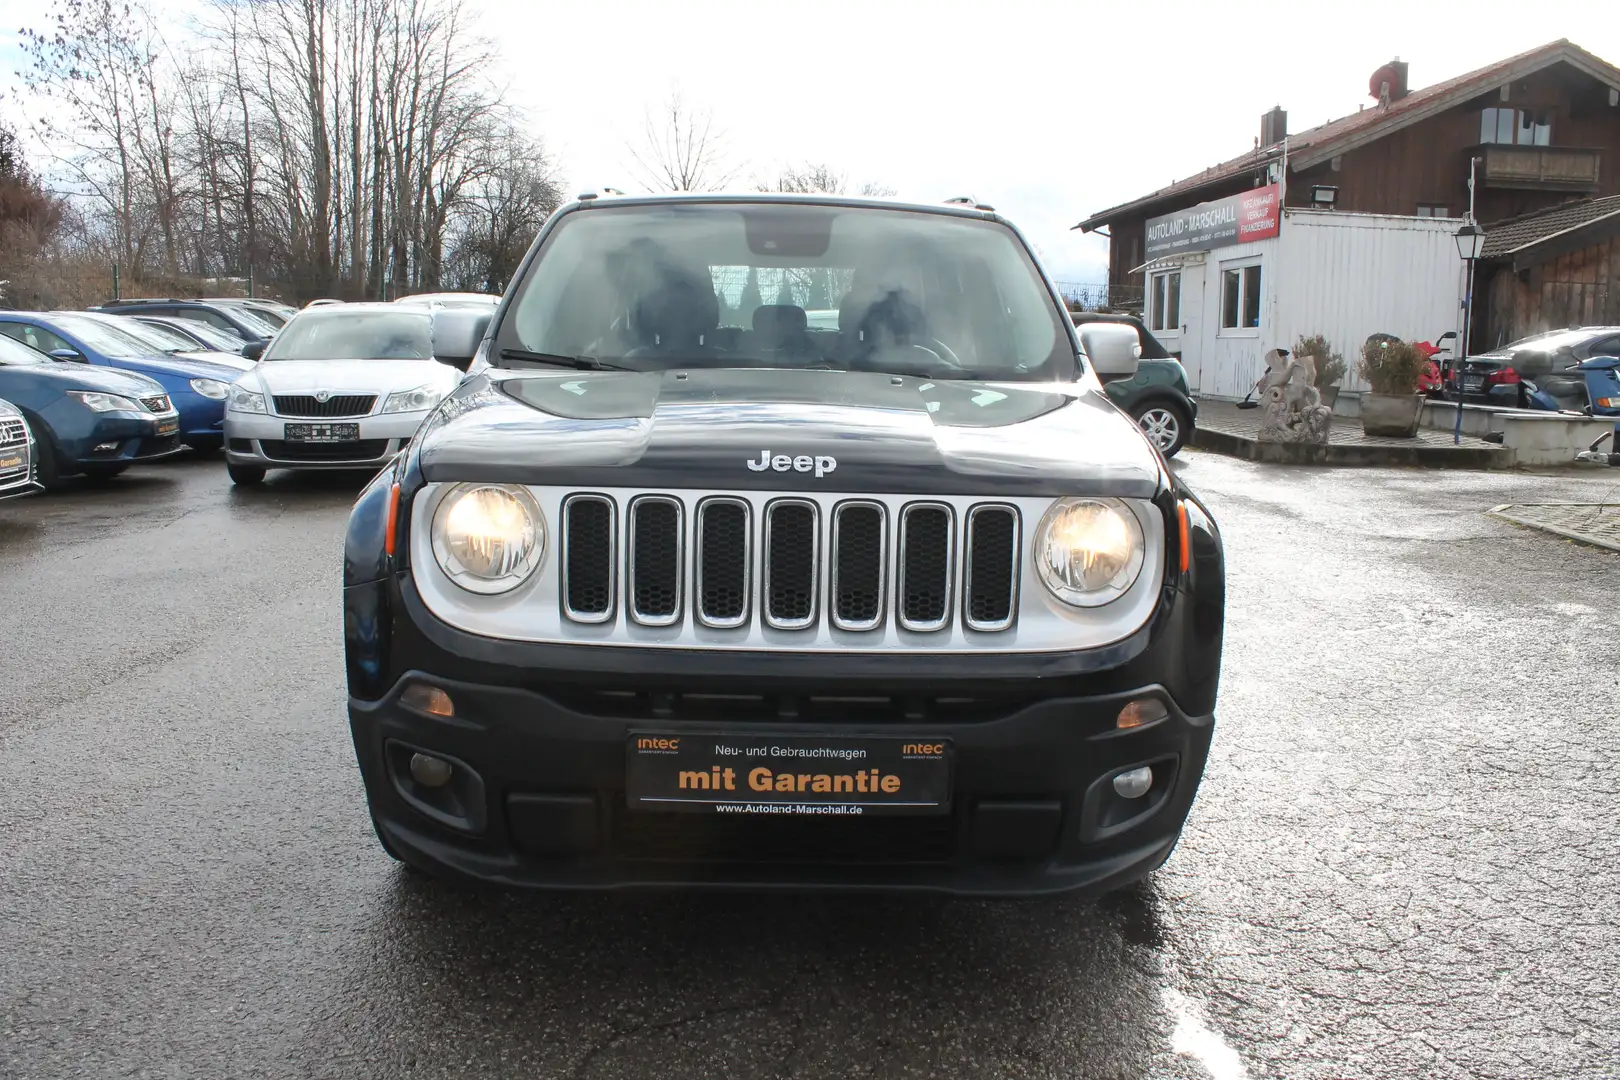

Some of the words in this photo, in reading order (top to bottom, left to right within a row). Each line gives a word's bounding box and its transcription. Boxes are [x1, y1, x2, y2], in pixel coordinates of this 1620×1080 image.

[1147, 219, 1184, 242] AUTOLAND
[1188, 205, 1236, 231] MARSCHALL
[747, 450, 837, 478] Jeep
[637, 738, 679, 750] intec
[902, 743, 944, 755] intec
[715, 745, 742, 756] Neu-
[746, 746, 767, 757] und
[770, 746, 867, 760] Gebrauchtwagen
[678, 765, 736, 791] mit
[748, 766, 901, 793] Garantie
[716, 804, 863, 815] www.Autoland-Marschall.de
